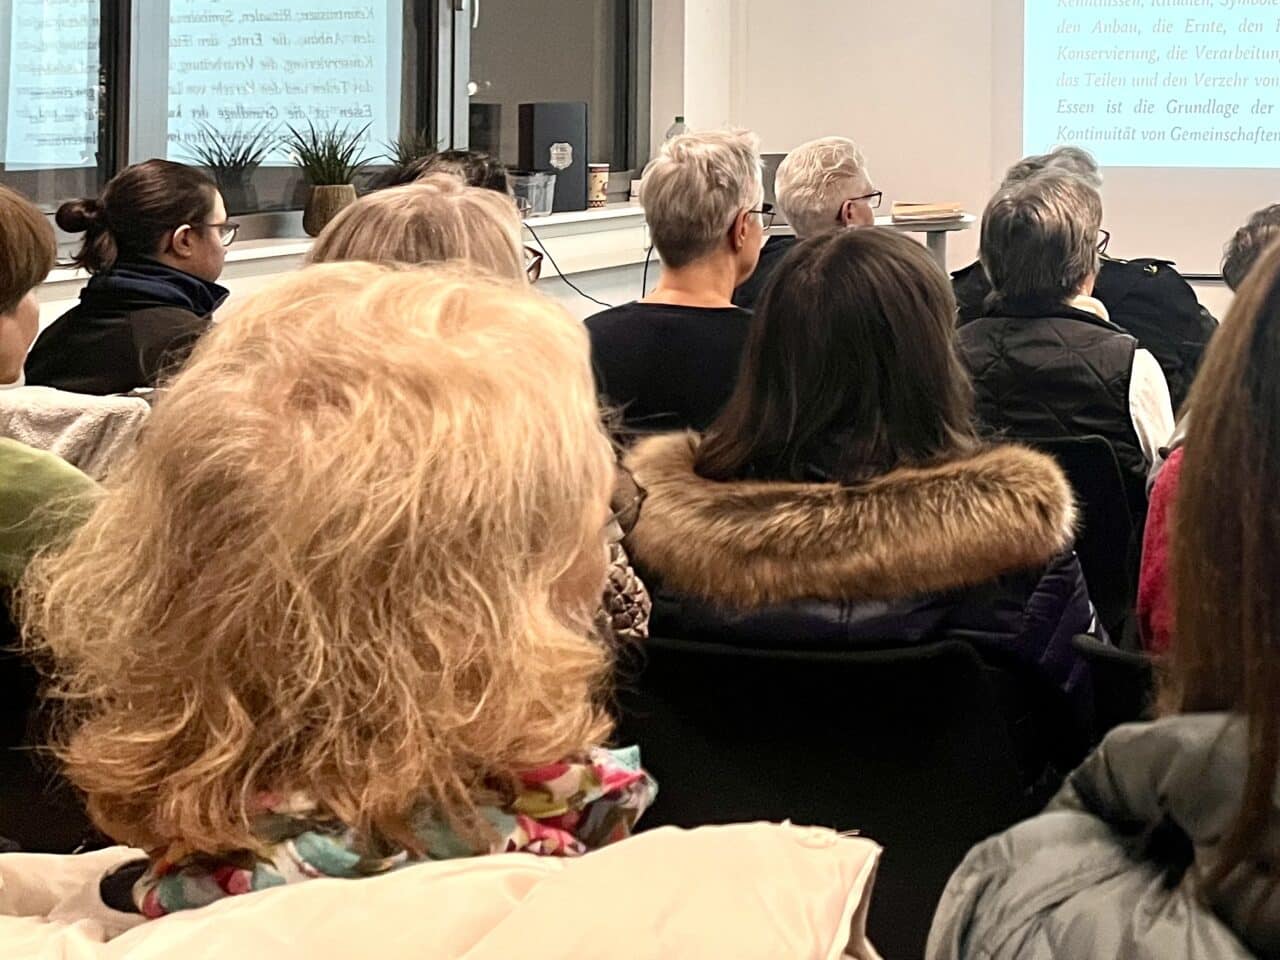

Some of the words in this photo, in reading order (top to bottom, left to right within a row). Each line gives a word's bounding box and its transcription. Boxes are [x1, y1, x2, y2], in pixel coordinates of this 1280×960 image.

[1056, 18, 1081, 34] den
[1091, 18, 1142, 37] Anbau,
[1152, 17, 1174, 33] die
[1184, 17, 1229, 36] Ernte,
[1238, 16, 1264, 33] den
[1057, 44, 1161, 64] Konservierung,
[1166, 44, 1188, 60] die
[1056, 71, 1080, 87] das
[1084, 71, 1127, 87] Teilen
[1131, 71, 1159, 87] und
[1162, 71, 1188, 87] den
[1192, 71, 1249, 87] Verzehr
[1254, 76, 1280, 87] von
[1056, 98, 1095, 115] Essen
[1105, 98, 1123, 115] ist
[1132, 98, 1156, 115] die
[1165, 97, 1240, 119] Grundlage
[1250, 98, 1275, 115] der
[1056, 124, 1137, 142] Kontinuität
[1140, 129, 1166, 142] von
